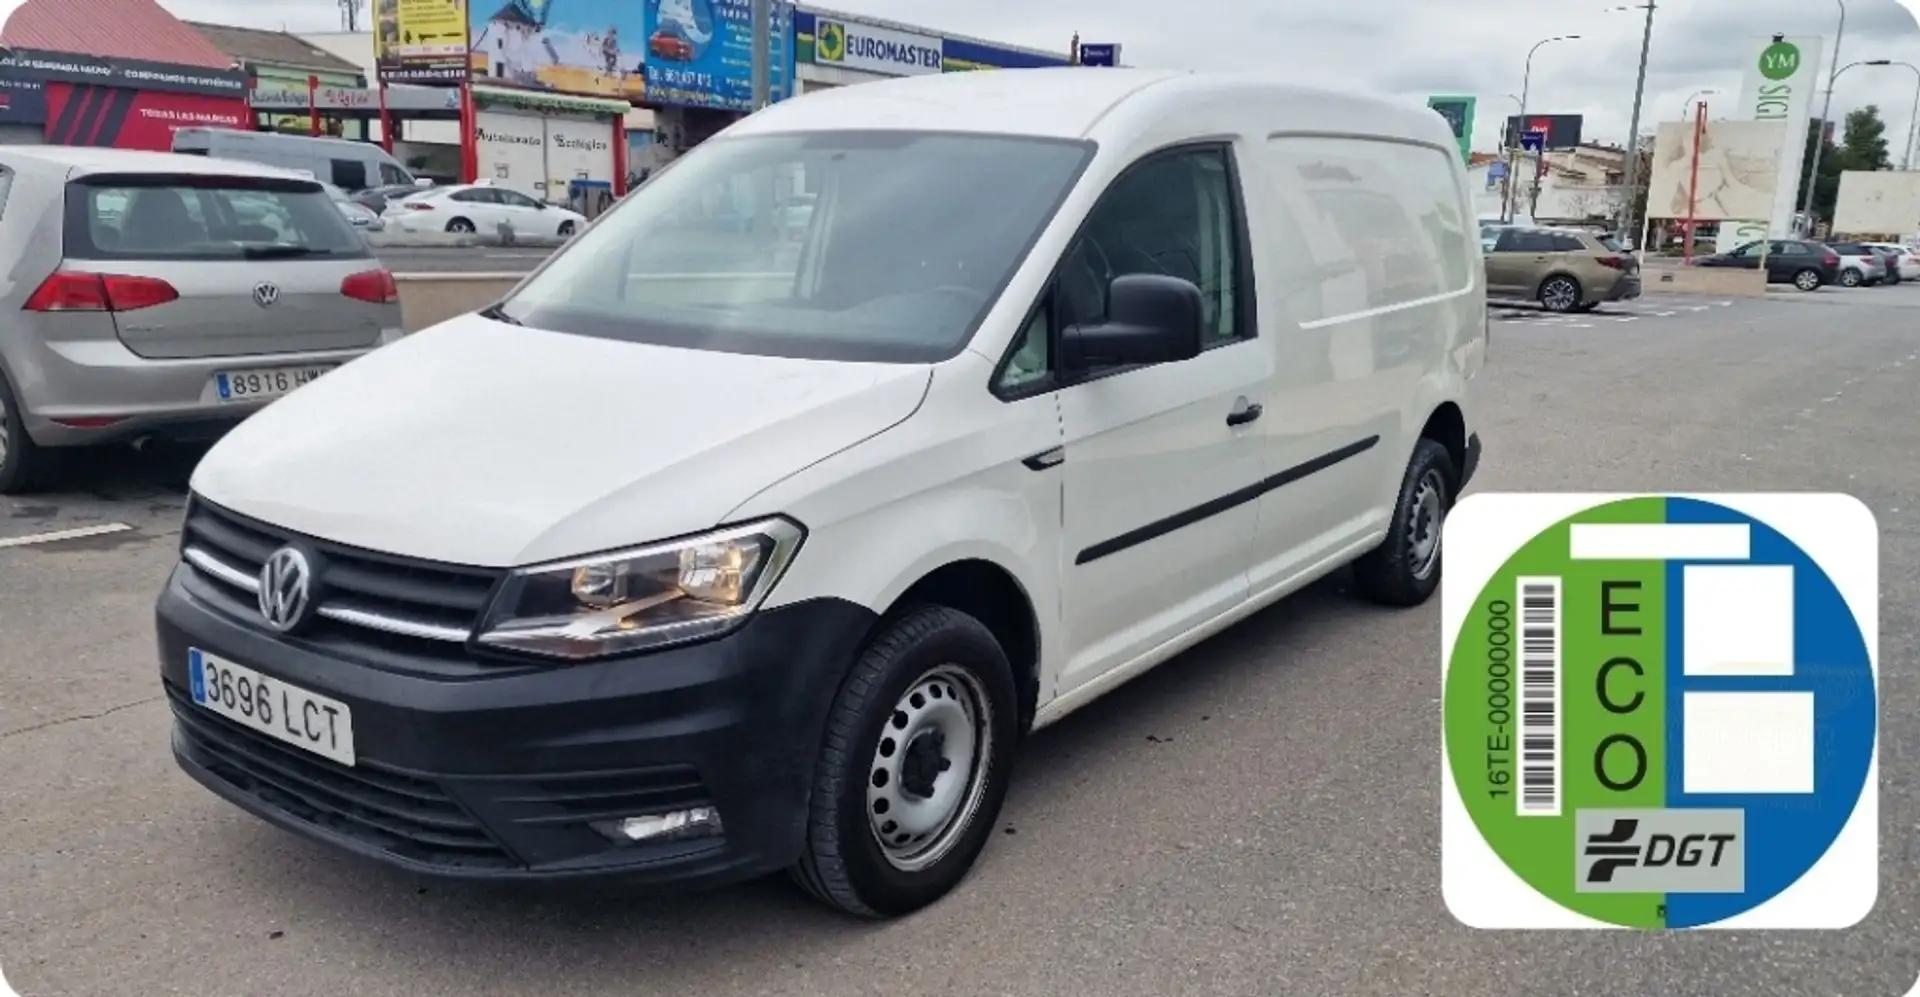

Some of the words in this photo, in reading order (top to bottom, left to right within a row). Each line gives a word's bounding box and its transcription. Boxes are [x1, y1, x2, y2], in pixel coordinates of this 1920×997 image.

[846, 34, 941, 69] EUROMASTER
[1764, 49, 1796, 70] YM
[140, 108, 175, 120] TODAS
[475, 127, 541, 146] Autolavado
[233, 373, 288, 395] 8916
[206, 662, 272, 725] 3696
[282, 691, 339, 750] LCT
